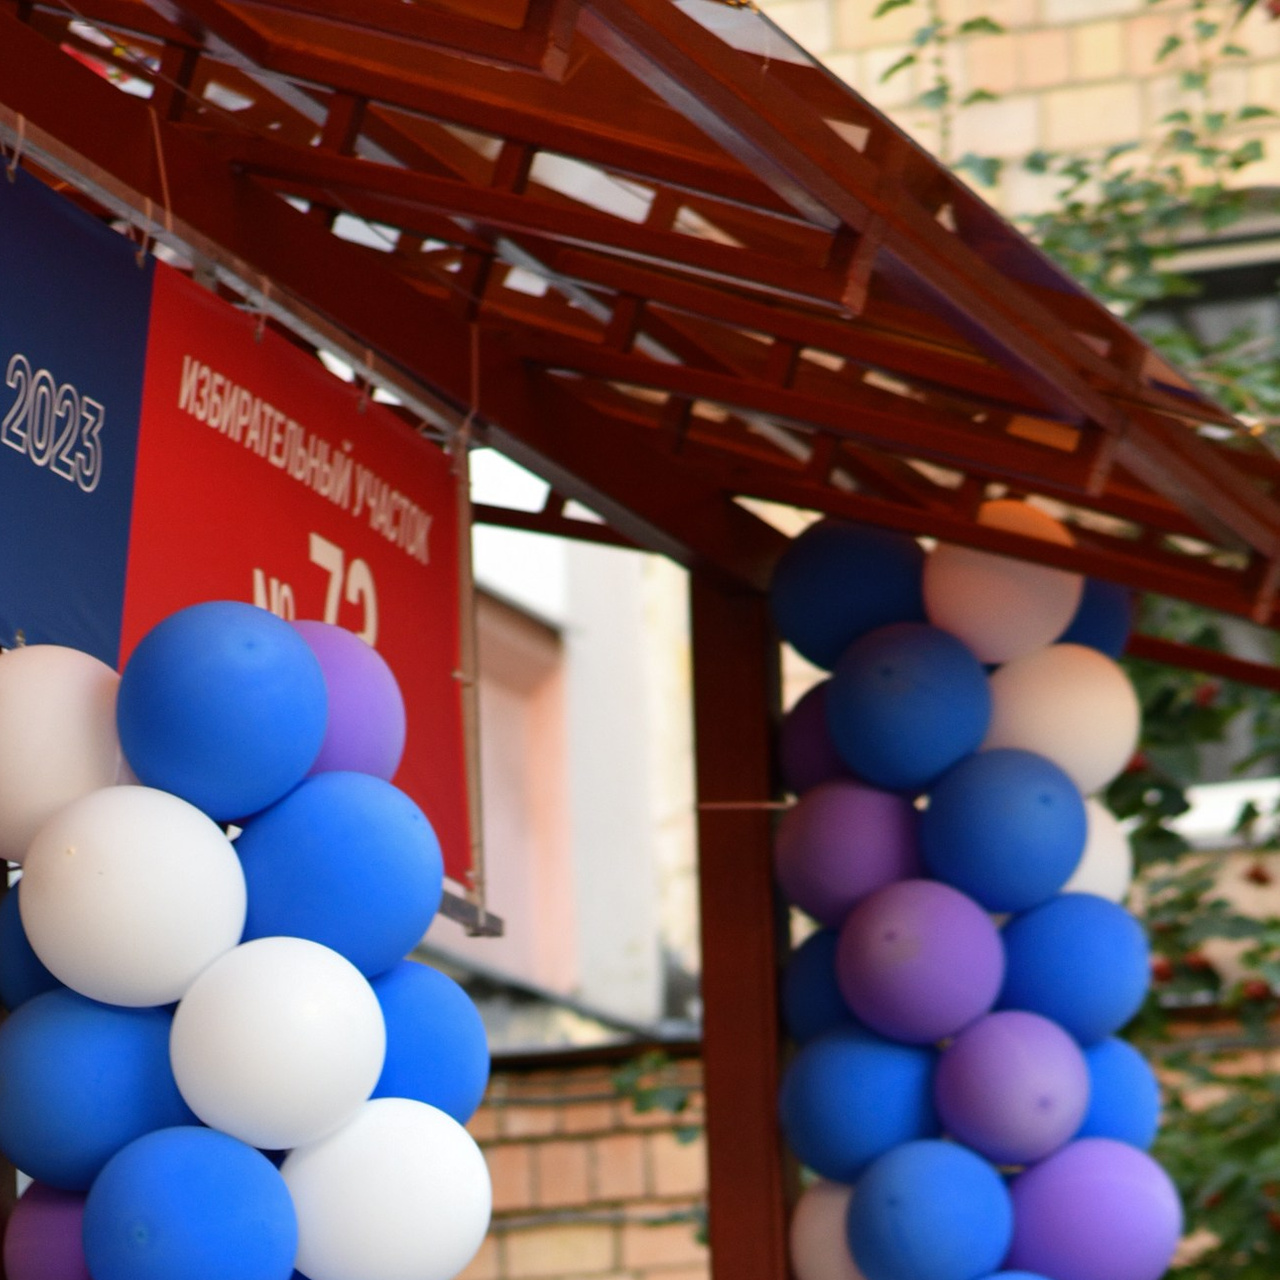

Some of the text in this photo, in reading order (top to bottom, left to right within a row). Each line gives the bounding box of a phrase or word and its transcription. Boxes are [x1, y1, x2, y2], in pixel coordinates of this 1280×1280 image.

[0, 354, 106, 493] 2023
[178, 355, 433, 566] ИЗБИРАТЕЛЬНЫЙ УЧАСТОК
